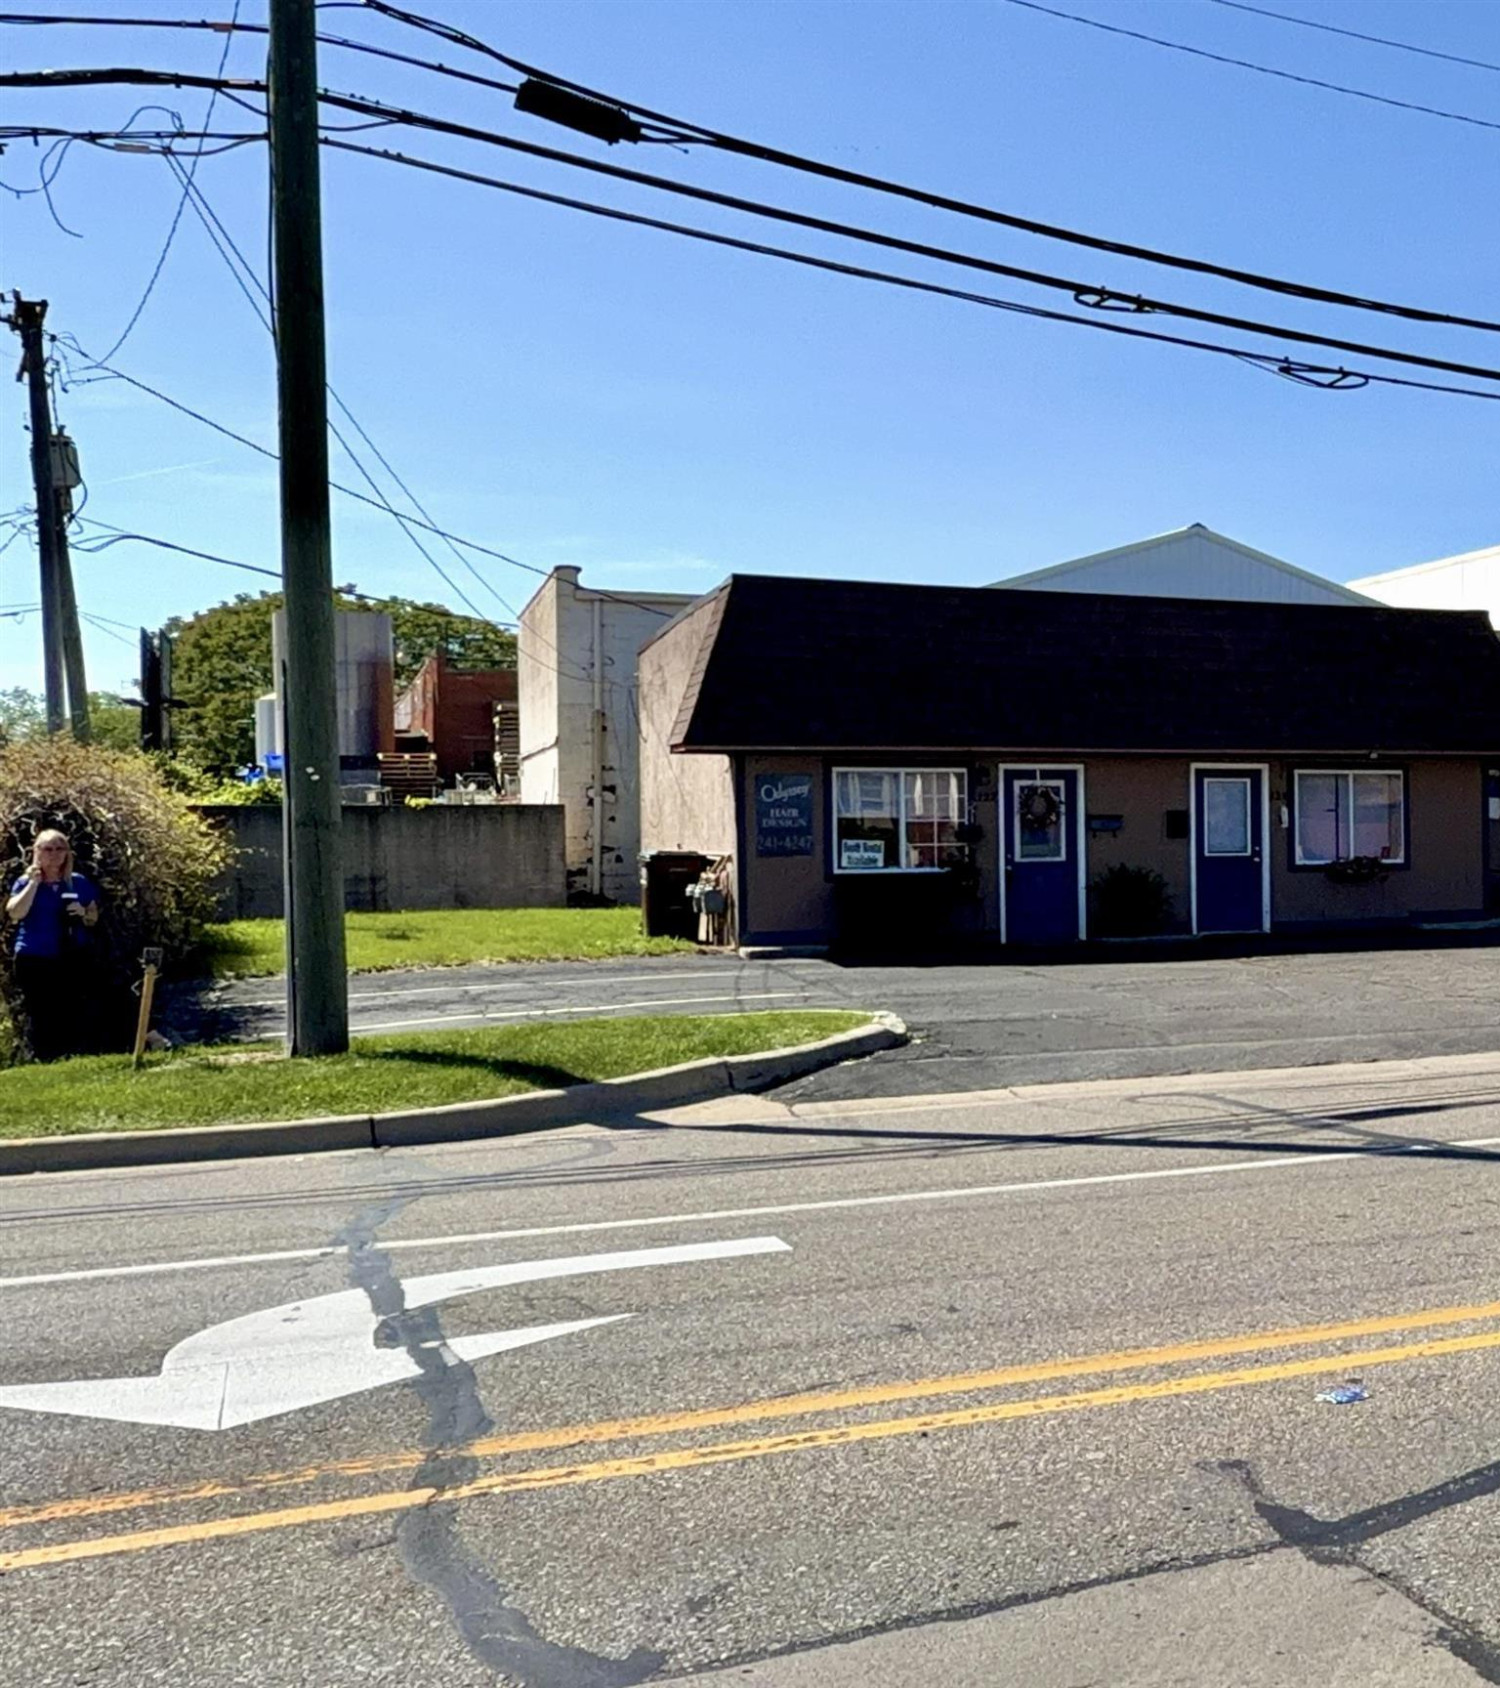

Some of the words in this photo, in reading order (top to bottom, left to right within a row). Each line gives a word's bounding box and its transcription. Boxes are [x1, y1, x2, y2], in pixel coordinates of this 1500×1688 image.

[769, 808, 800, 818] HAIR
[761, 818, 808, 828] DESIGN
[757, 834, 813, 850] 241-4247
